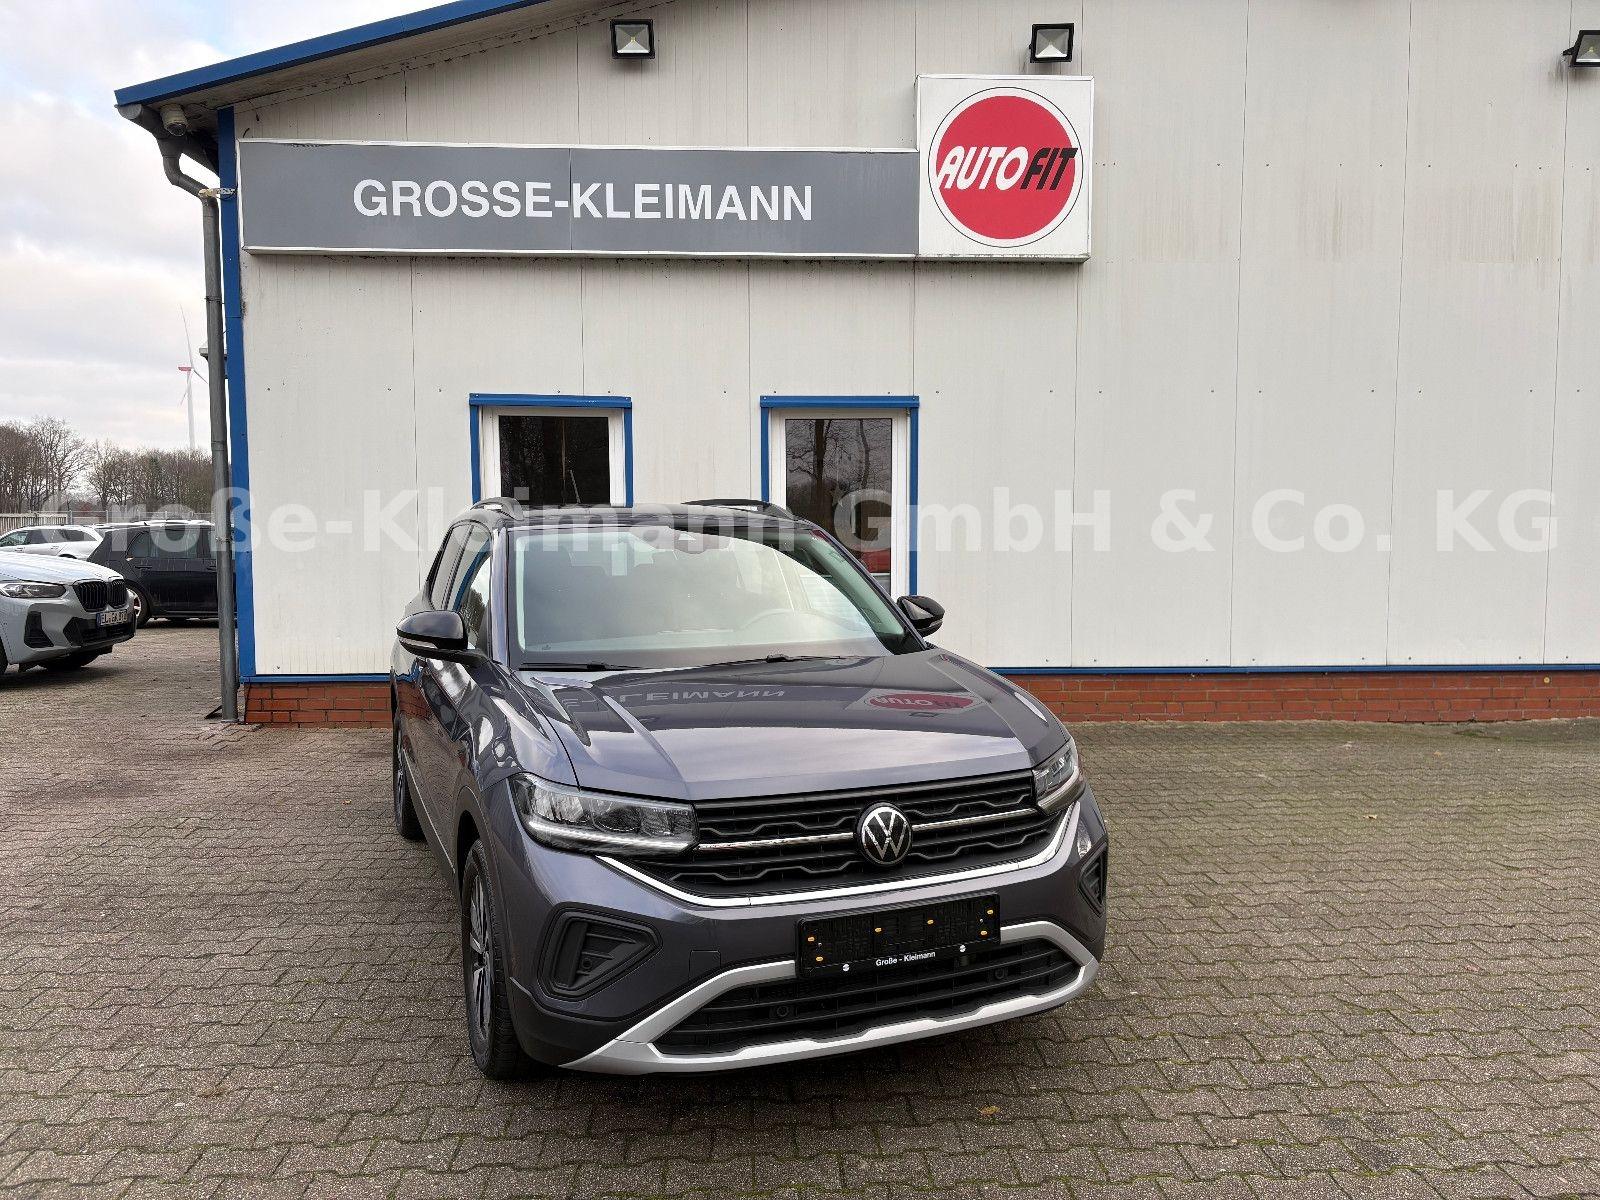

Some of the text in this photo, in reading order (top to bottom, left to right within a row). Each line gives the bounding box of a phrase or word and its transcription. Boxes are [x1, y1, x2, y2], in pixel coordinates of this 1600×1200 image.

[937, 145, 1079, 191] AUTOFIT
[353, 179, 813, 221] GROSSE-KLEIMANN
[903, 951, 936, 962] Kleimann
